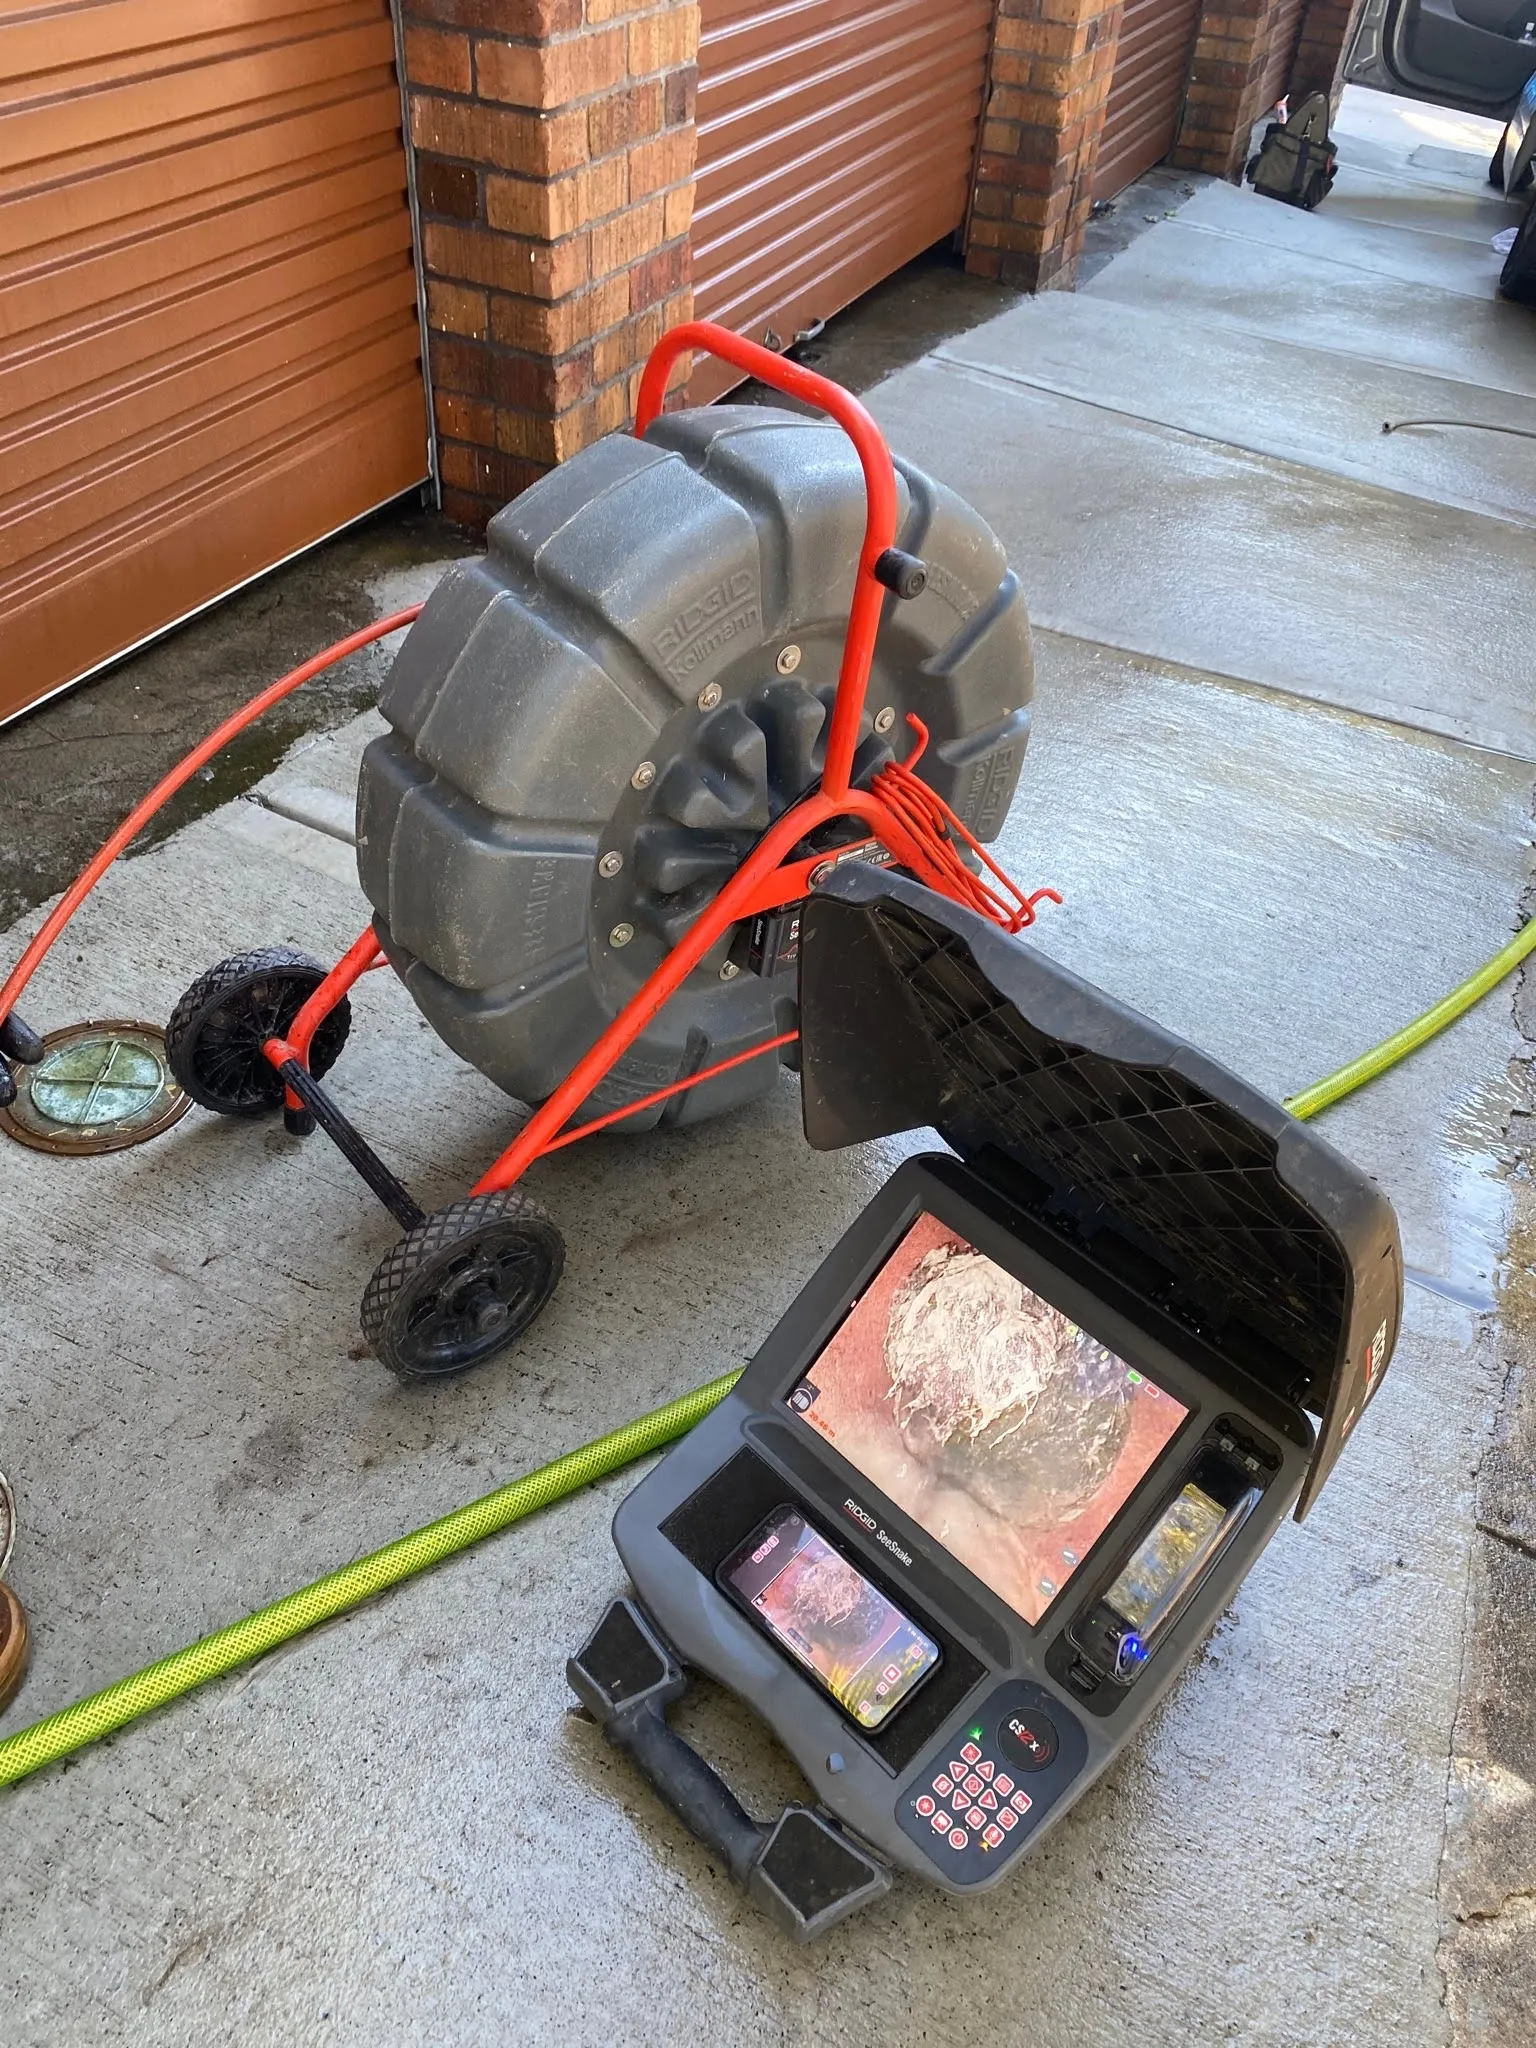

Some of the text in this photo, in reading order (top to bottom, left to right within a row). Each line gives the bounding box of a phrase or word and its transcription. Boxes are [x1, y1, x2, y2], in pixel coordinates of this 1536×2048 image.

[653, 567, 753, 657] RIDGID
[843, 1498, 913, 1567] RIDGID SeeSnake
